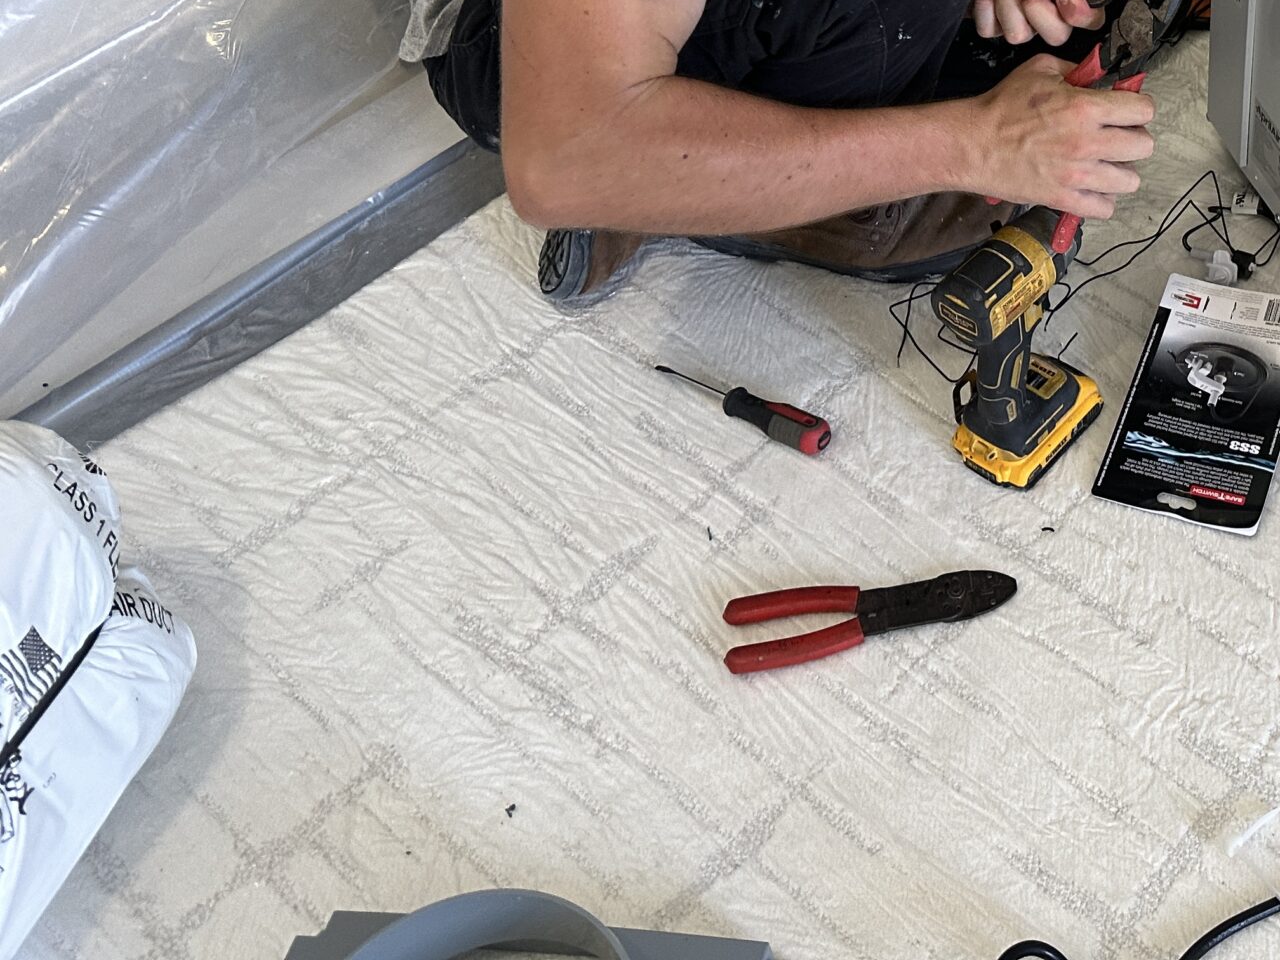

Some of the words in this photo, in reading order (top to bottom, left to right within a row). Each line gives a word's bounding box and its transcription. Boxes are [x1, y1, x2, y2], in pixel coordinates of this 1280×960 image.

[1229, 440, 1261, 455] SS3
[96, 519, 106, 537] 1
[108, 590, 142, 619] AIR
